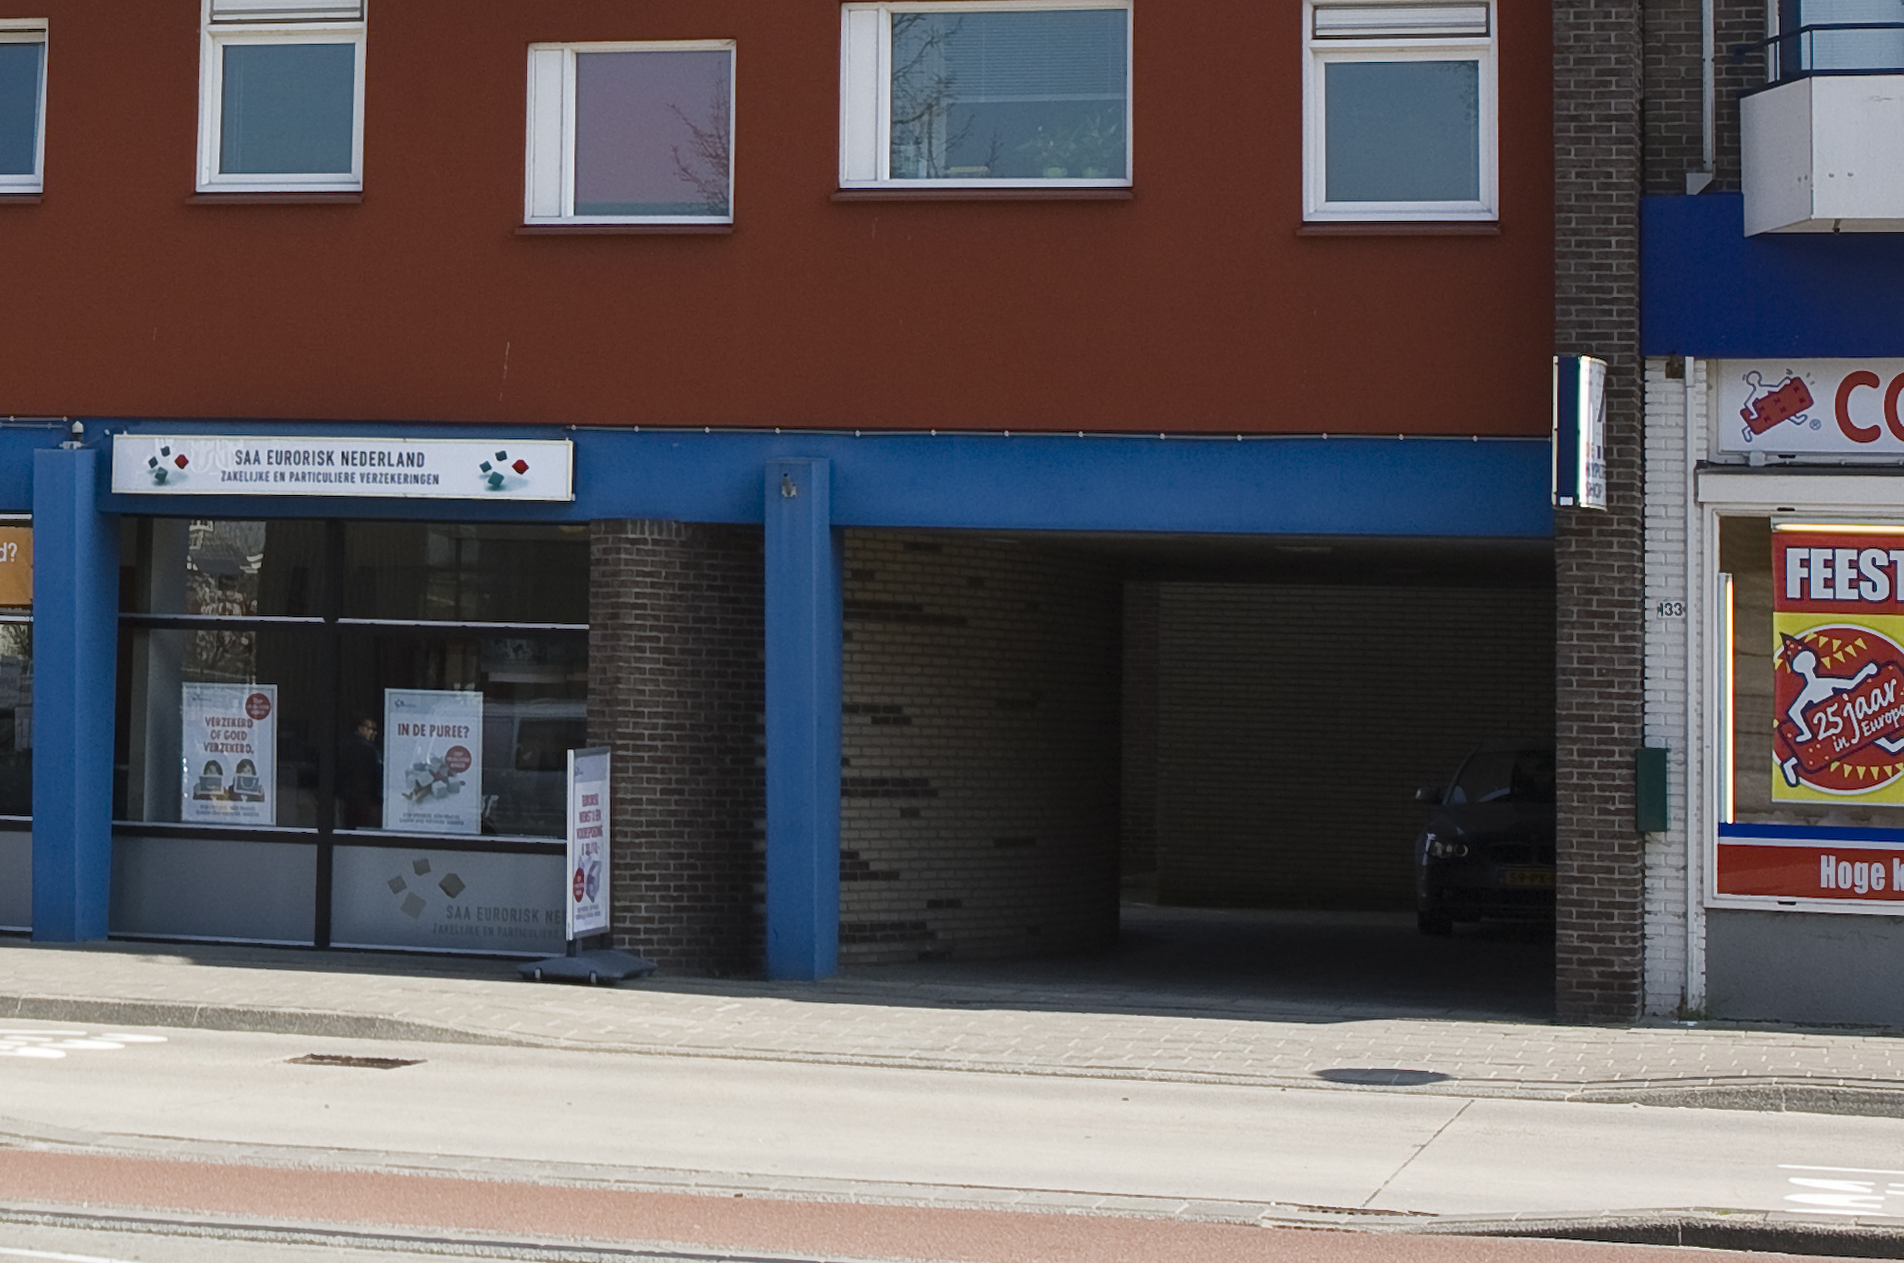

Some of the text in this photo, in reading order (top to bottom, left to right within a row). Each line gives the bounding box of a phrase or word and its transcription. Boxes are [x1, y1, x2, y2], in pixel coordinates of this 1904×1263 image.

[234, 449, 426, 469] SAA EURORISK NEDERLAND
[220, 470, 440, 486] ZAKELIJKE EN PARTICULIERE VERZEKERINGEN
[1659, 602, 1683, 617] 133
[1813, 678, 1897, 744] 25 jaar
[204, 716, 254, 729] VERZEKERD
[397, 722, 470, 738] IN DE PUREE?
[210, 729, 248, 741] OF GOED
[1832, 735, 1851, 752] in
[1820, 854, 1886, 894] Hoge
[445, 904, 471, 921] SAA
[476, 905, 540, 924] EURORISK
